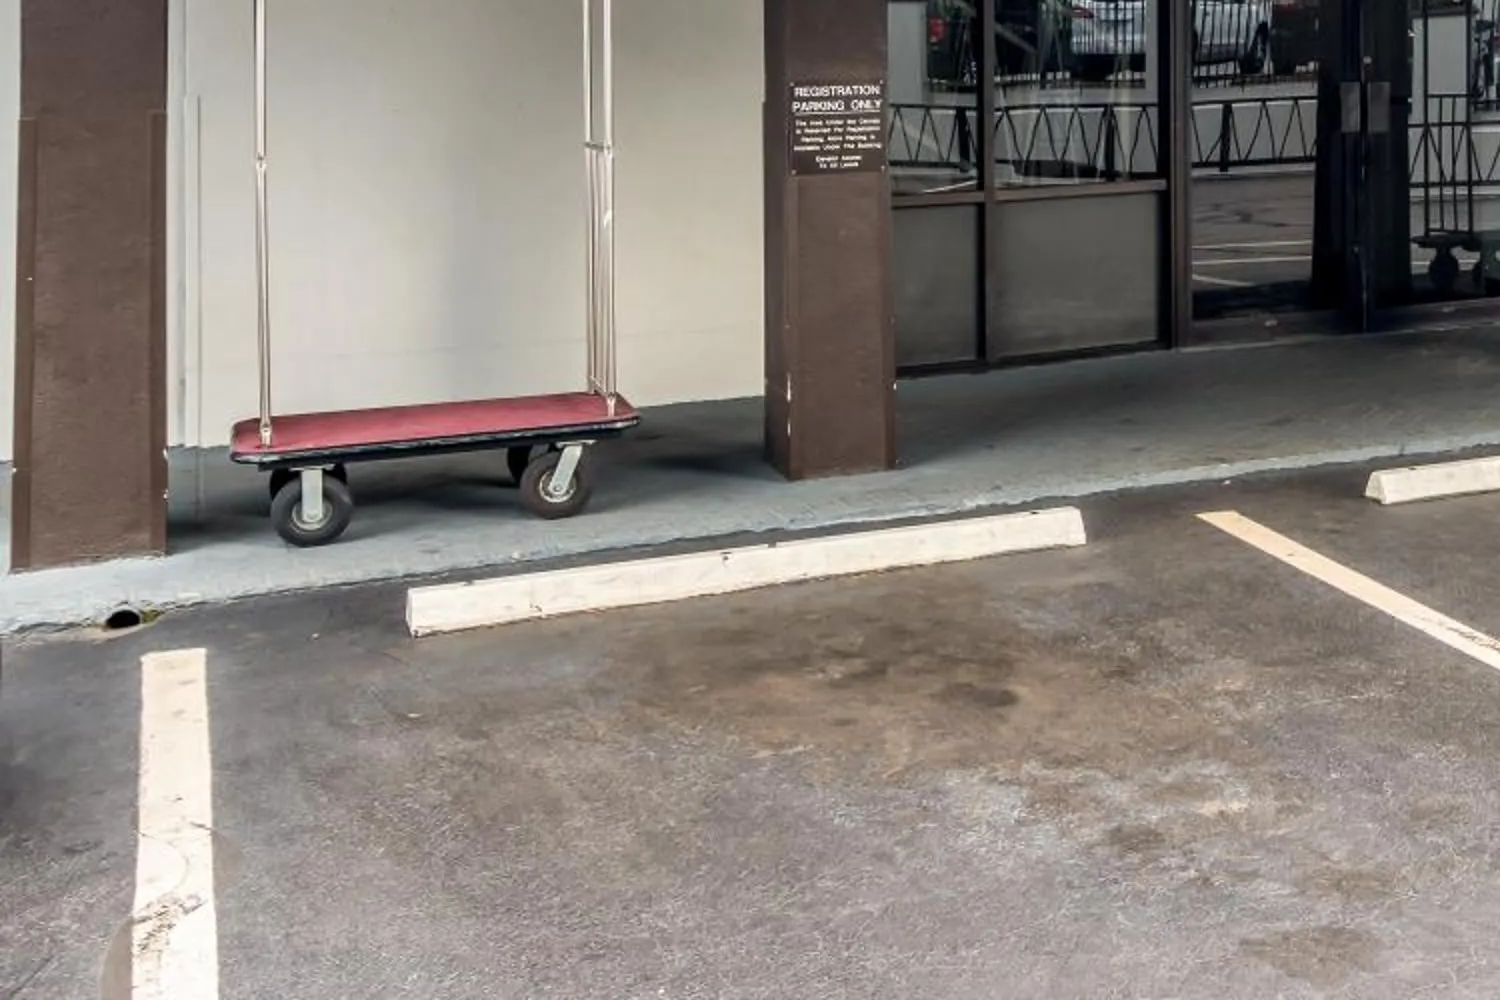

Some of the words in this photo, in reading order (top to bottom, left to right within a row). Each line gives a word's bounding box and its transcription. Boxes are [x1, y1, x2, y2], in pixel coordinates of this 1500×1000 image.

[794, 85, 881, 97] REGISTRATION
[792, 100, 845, 112] PARKING
[851, 99, 882, 110] ONLY
